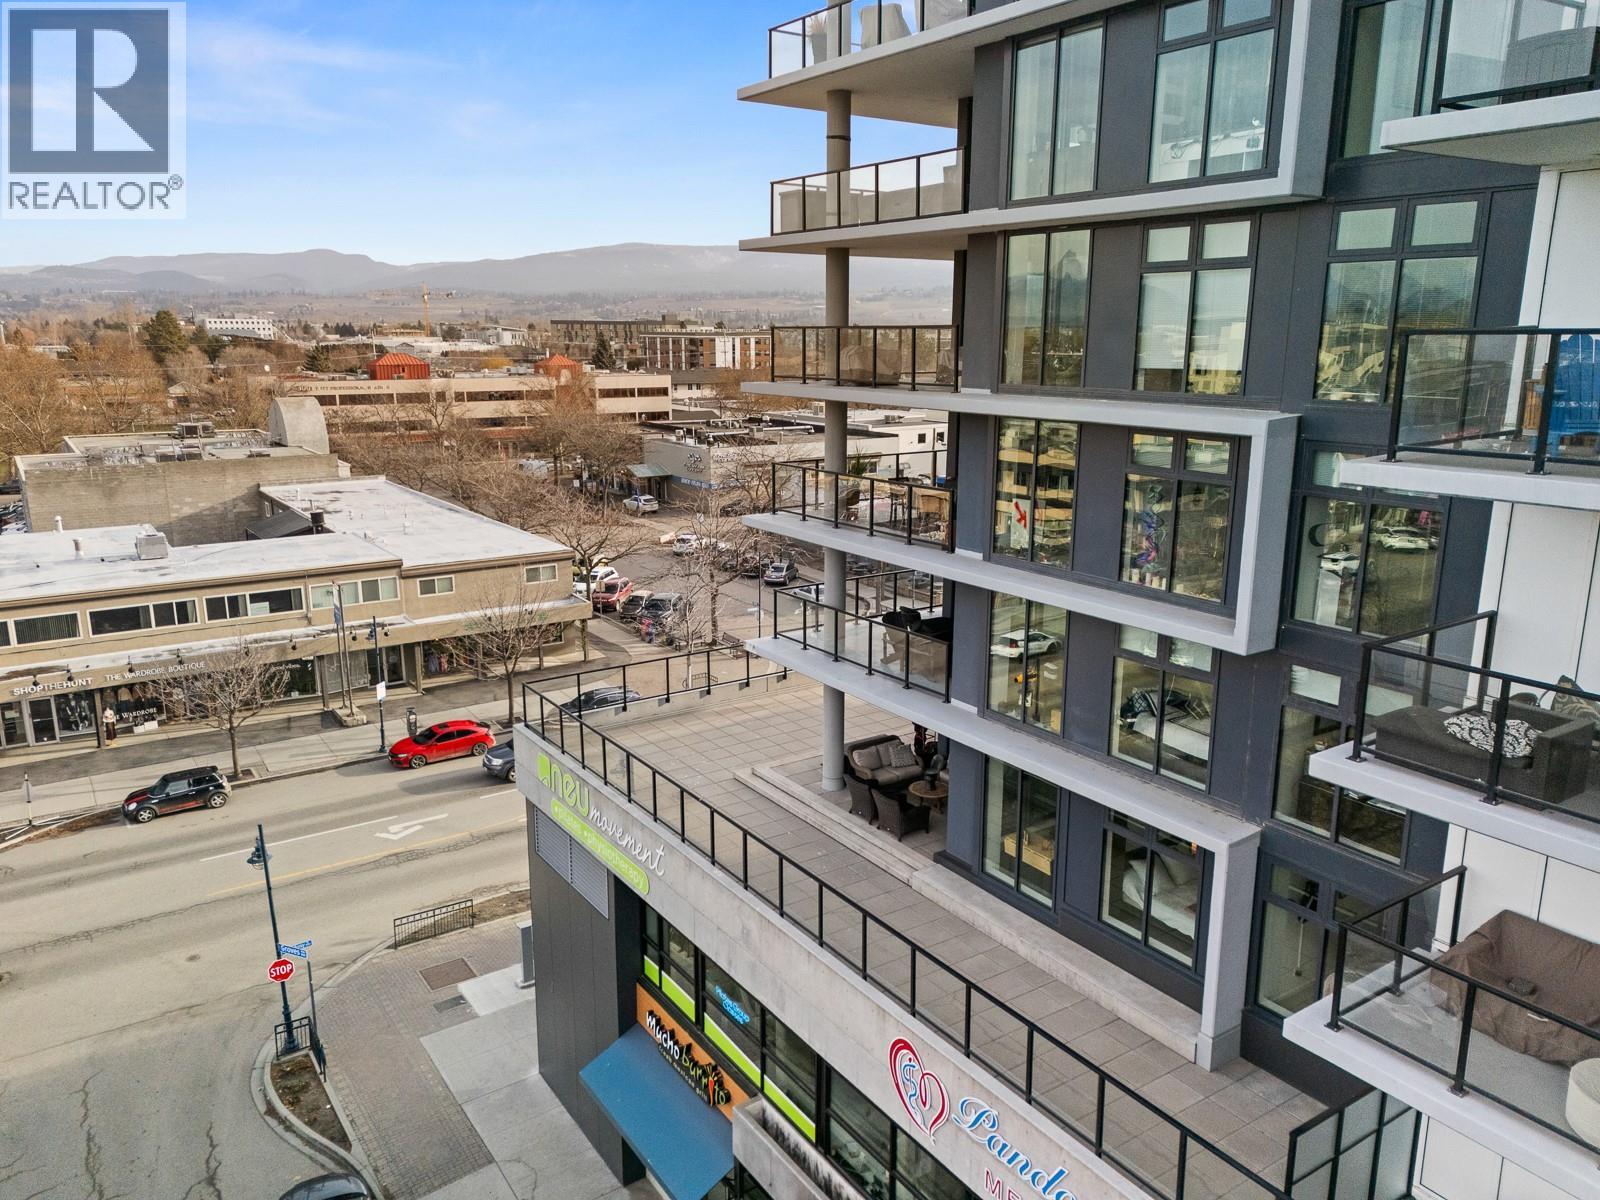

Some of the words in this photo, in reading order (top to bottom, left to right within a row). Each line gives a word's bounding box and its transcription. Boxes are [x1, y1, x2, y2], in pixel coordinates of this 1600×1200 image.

[105, 673, 122, 682] THE
[123, 667, 165, 679] WARDROBE
[168, 661, 206, 673] BOUTIQUE
[589, 806, 666, 876] movement
[270, 963, 292, 977] STOP
